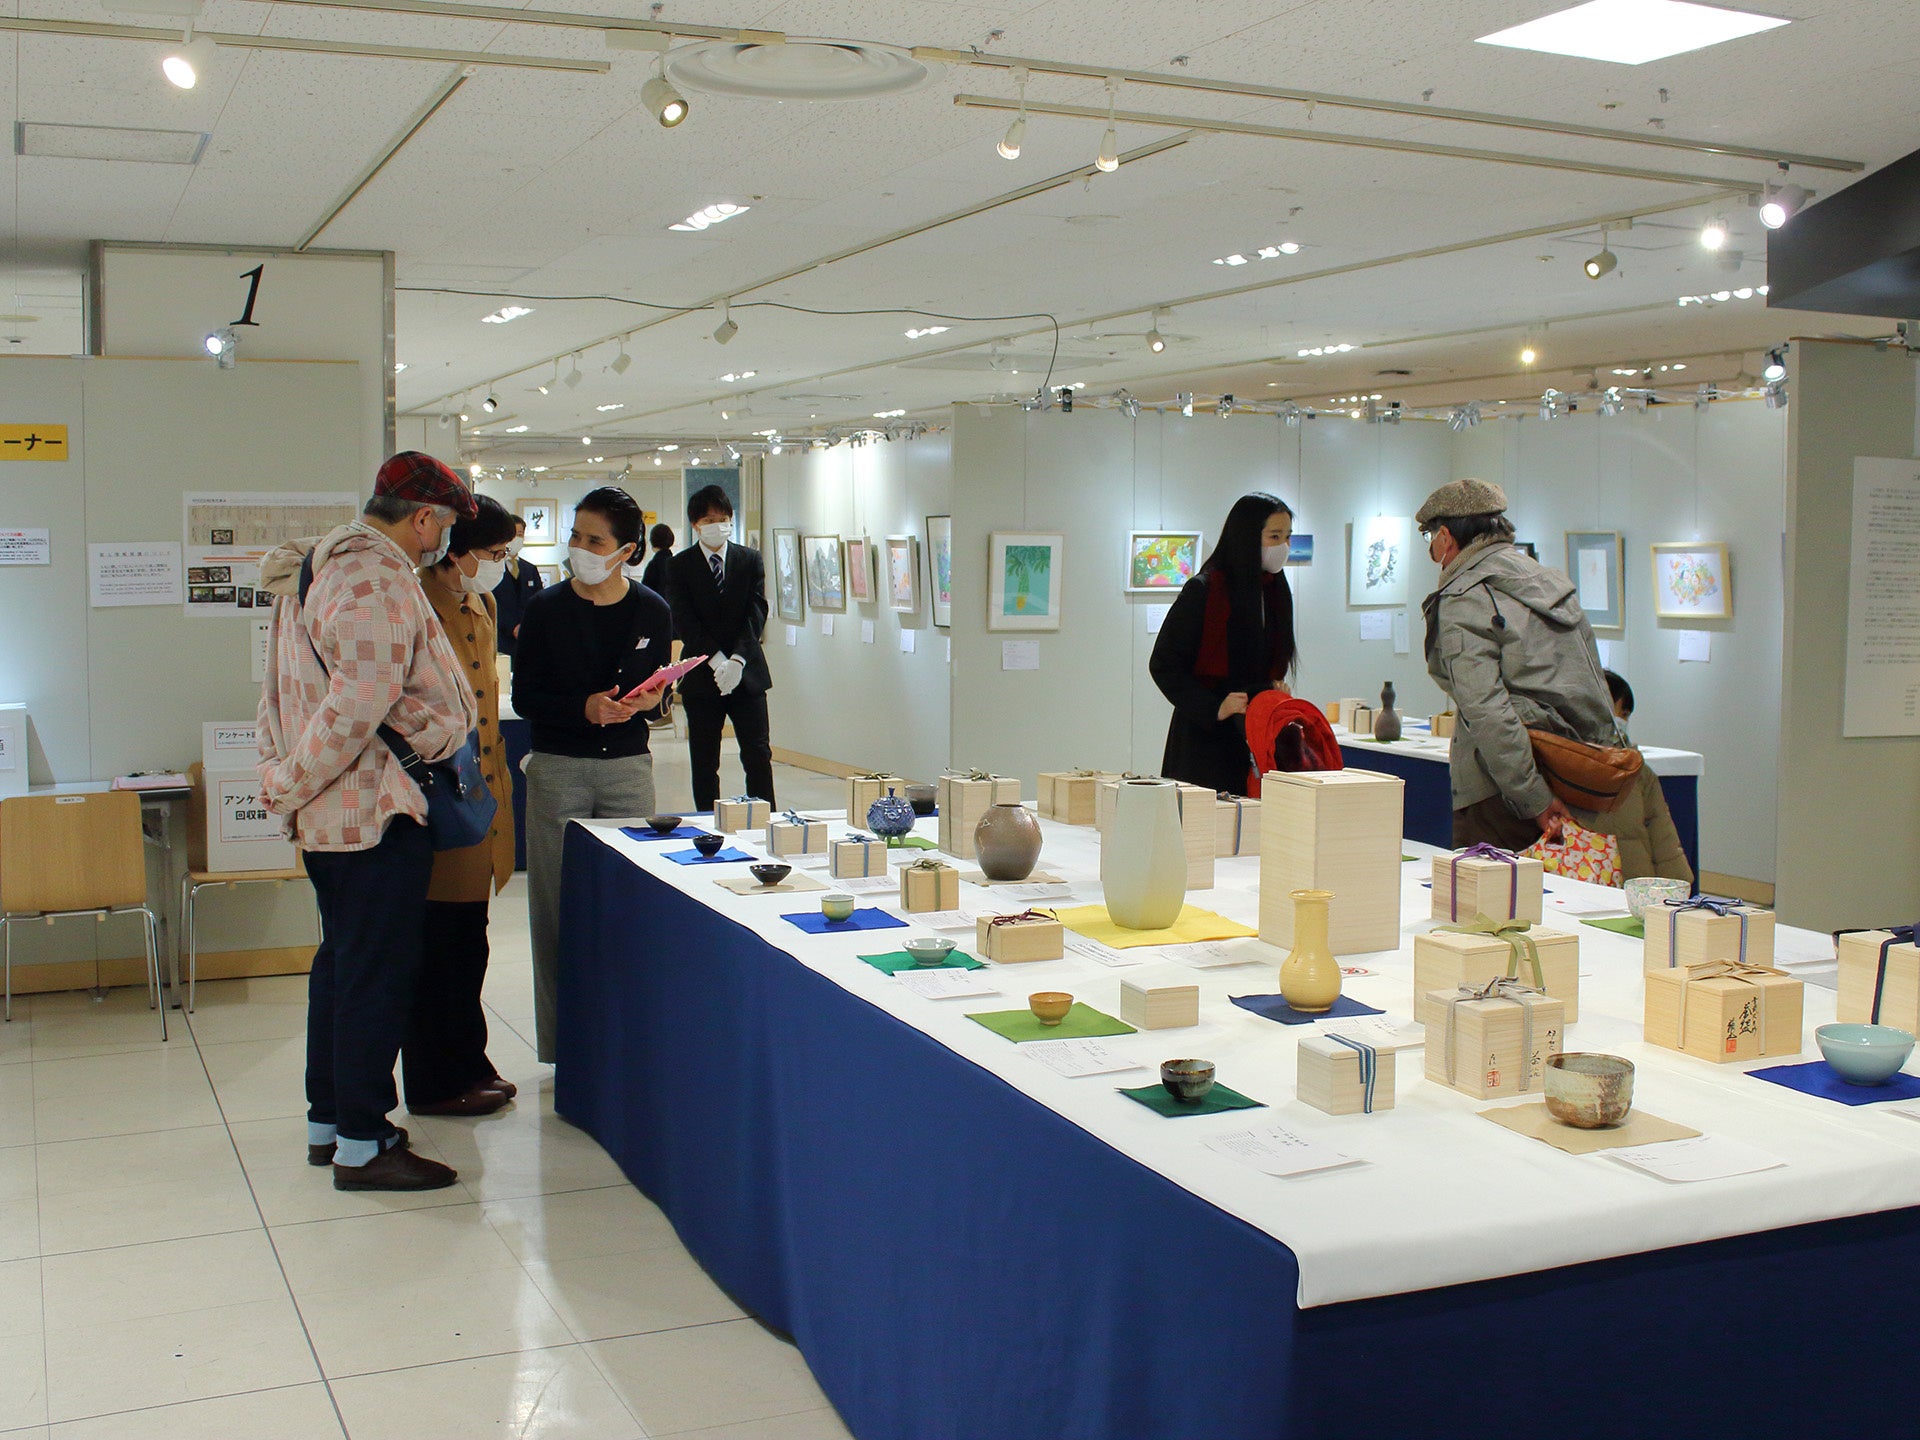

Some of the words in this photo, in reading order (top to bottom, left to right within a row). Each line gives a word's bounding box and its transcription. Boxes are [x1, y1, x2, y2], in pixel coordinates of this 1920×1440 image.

[229, 263, 264, 326] 1
[4, 433, 63, 451] ーナー
[224, 794, 256, 806] アンケ
[235, 809, 268, 820] 回収箱
